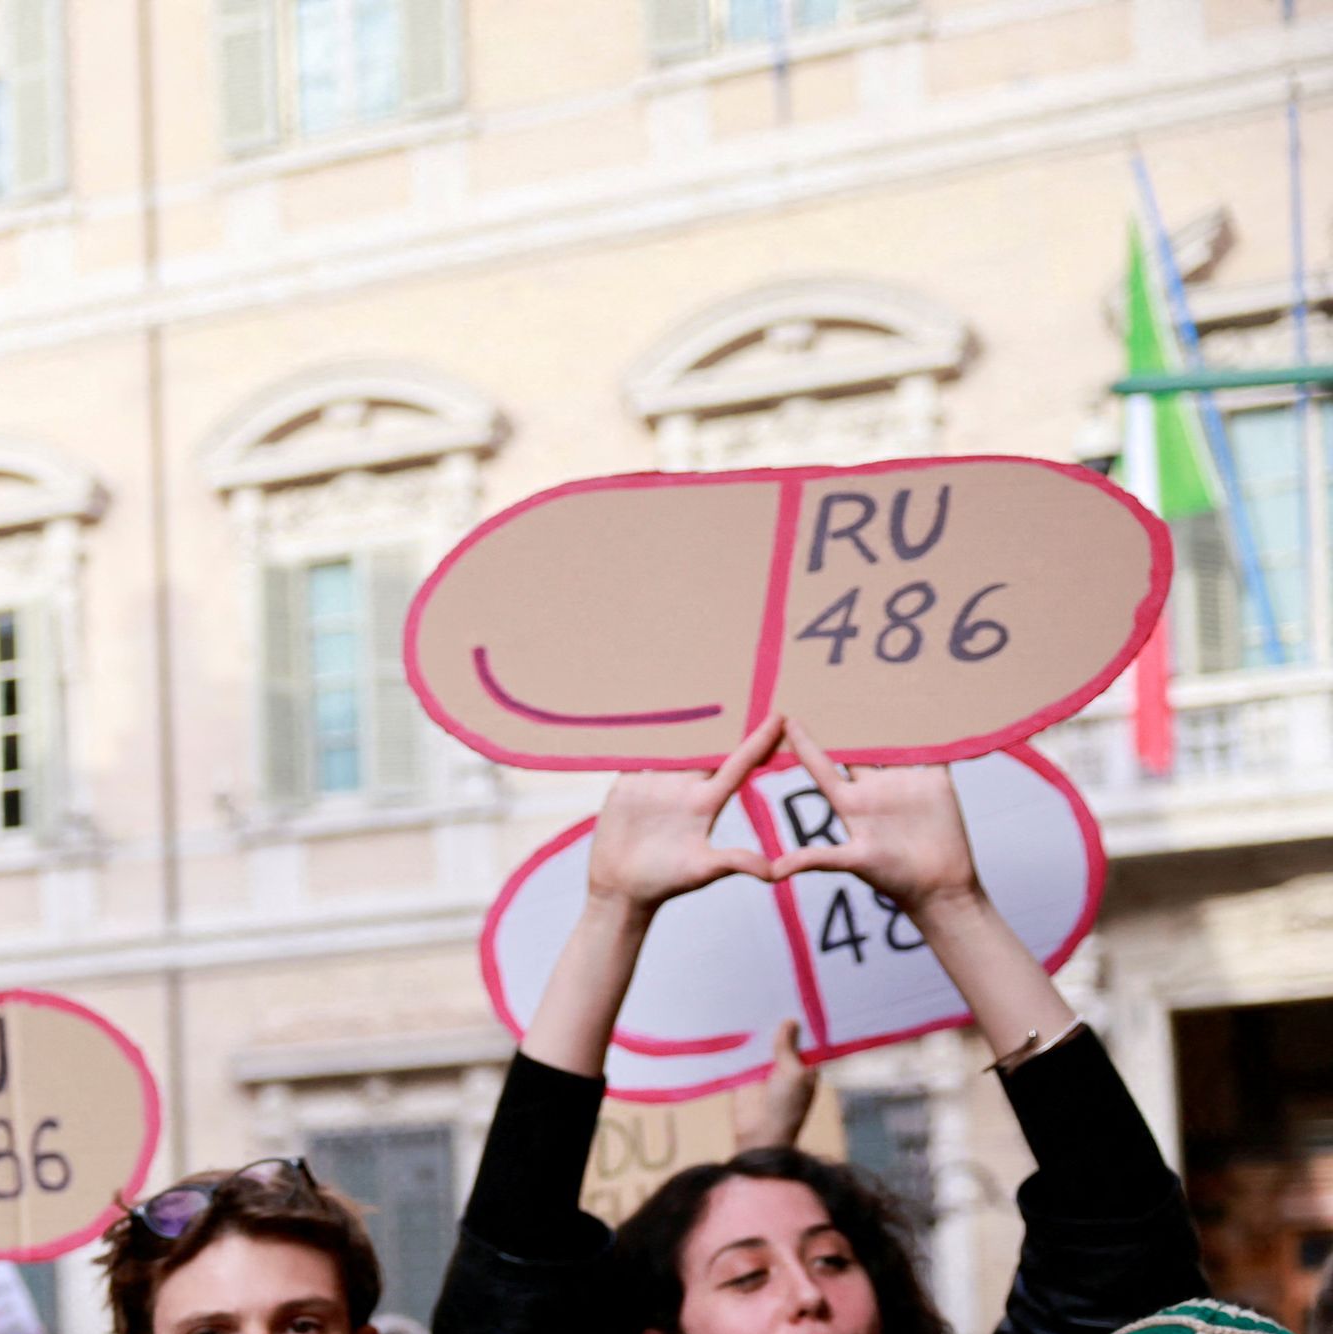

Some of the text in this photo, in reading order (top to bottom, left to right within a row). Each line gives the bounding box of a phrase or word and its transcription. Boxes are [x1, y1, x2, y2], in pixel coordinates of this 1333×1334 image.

[806, 485, 951, 573] RU
[794, 579, 1011, 666] 486
[782, 786, 841, 848] R
